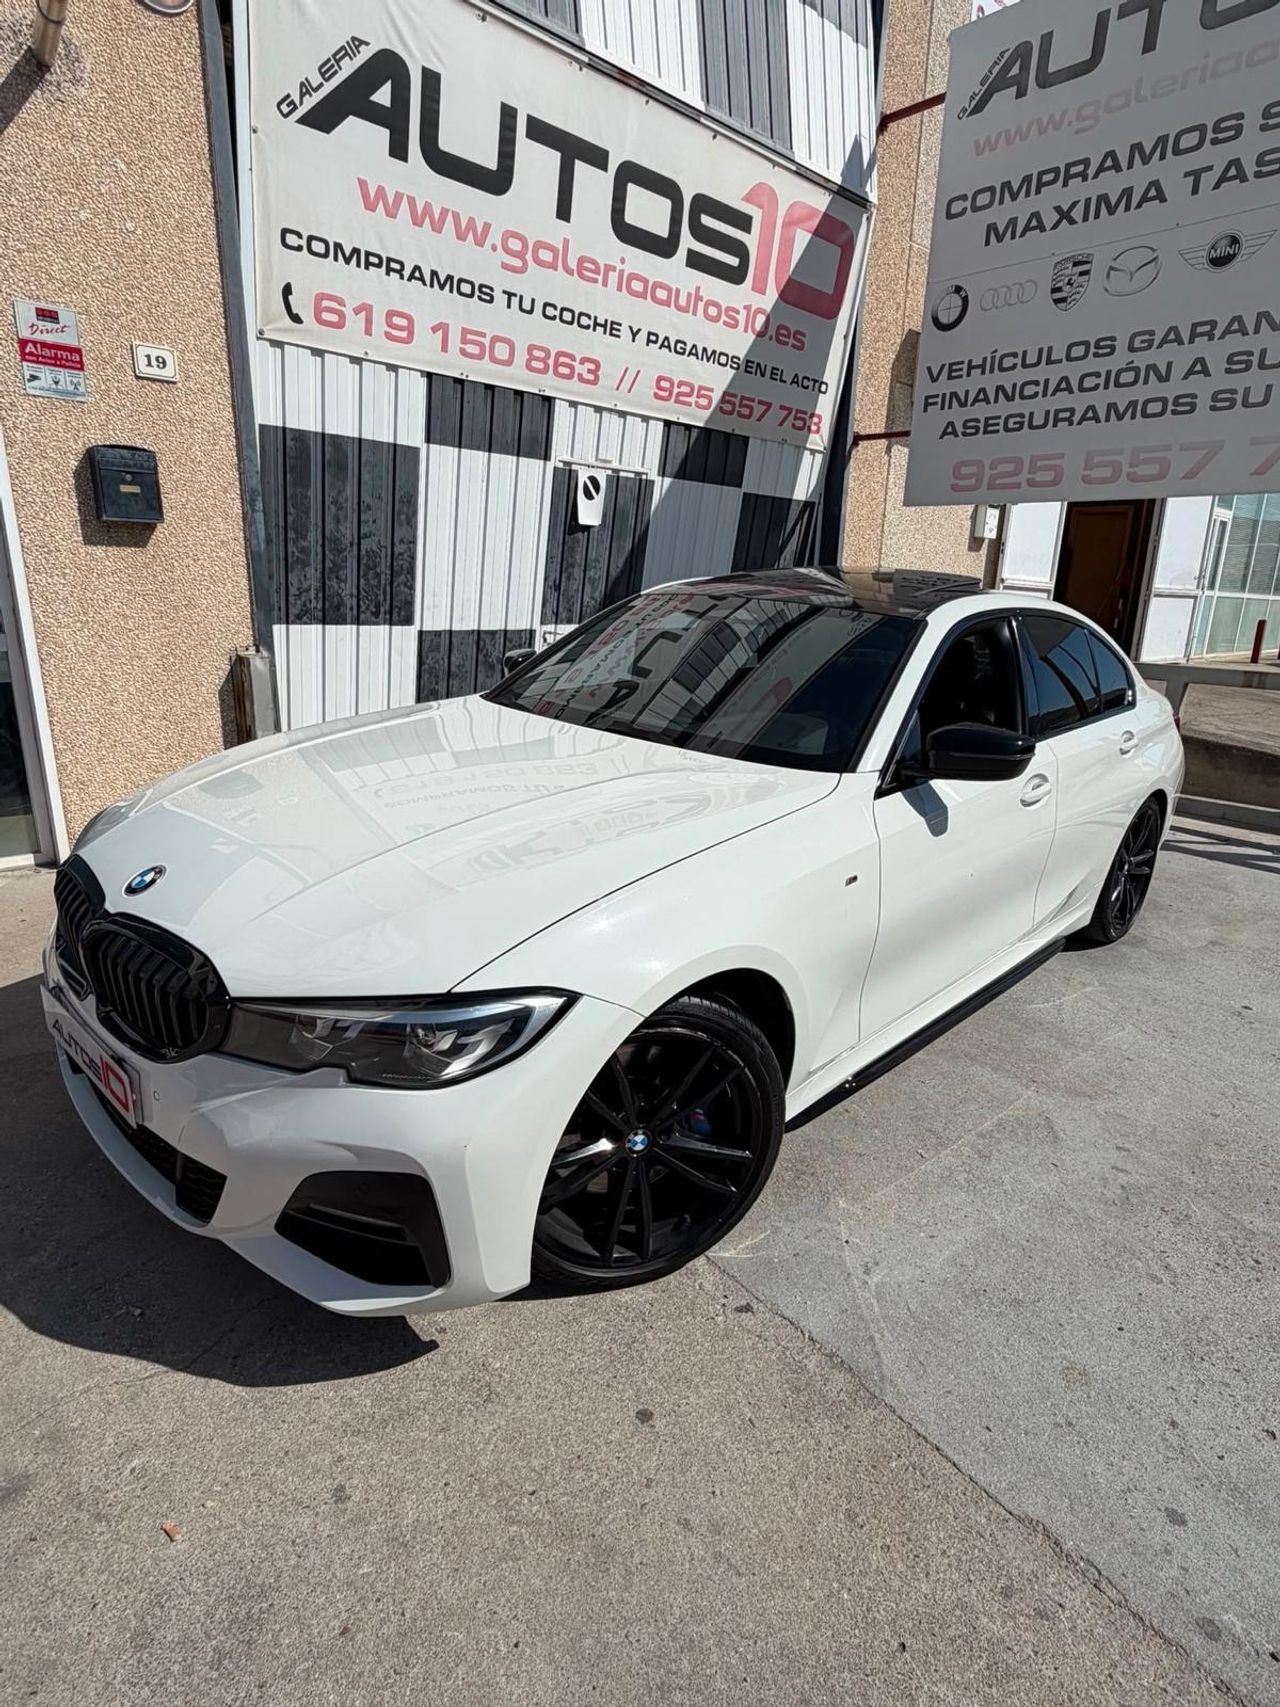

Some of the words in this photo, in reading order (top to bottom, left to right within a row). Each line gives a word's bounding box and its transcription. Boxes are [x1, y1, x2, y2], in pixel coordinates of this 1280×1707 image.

[276, 35, 371, 119] GALERIA
[957, 48, 1011, 121] GALERIA
[294, 48, 855, 320] AUTOS10
[945, 112, 1244, 221] COMPRAMOS
[984, 179, 1168, 248] MAXIMA
[357, 177, 807, 351] www.galeriaautos10.es
[1208, 243, 1240, 260] MINI
[28, 322, 69, 335] Direct
[280, 227, 495, 304] COMPRAMOS
[502, 289, 536, 315] TU
[541, 301, 622, 339] COCHE
[628, 325, 642, 343] Y
[646, 330, 741, 371] PAGAMOS
[744, 360, 767, 378] EN
[769, 366, 788, 384] EL
[790, 373, 829, 395] ACTO
[25, 342, 81, 361] Alarma
[144, 353, 168, 370] 19
[312, 291, 415, 345] 619
[430, 321, 516, 368] 150
[524, 343, 601, 387] 863
[653, 375, 714, 411] 925
[718, 390, 773, 422] 557
[777, 402, 823, 434] 753
[926, 335, 1117, 384] VEHÍCULOS
[1127, 310, 1280, 354] GARAN
[923, 359, 1173, 413] FINANCIACIÓN
[1181, 357, 1212, 381] A
[939, 392, 1198, 440] ASEGURAMOS
[1209, 384, 1273, 412] SU
[950, 452, 1065, 493] 925
[1081, 440, 1226, 486] 557
[1248, 435, 1280, 477] 7
